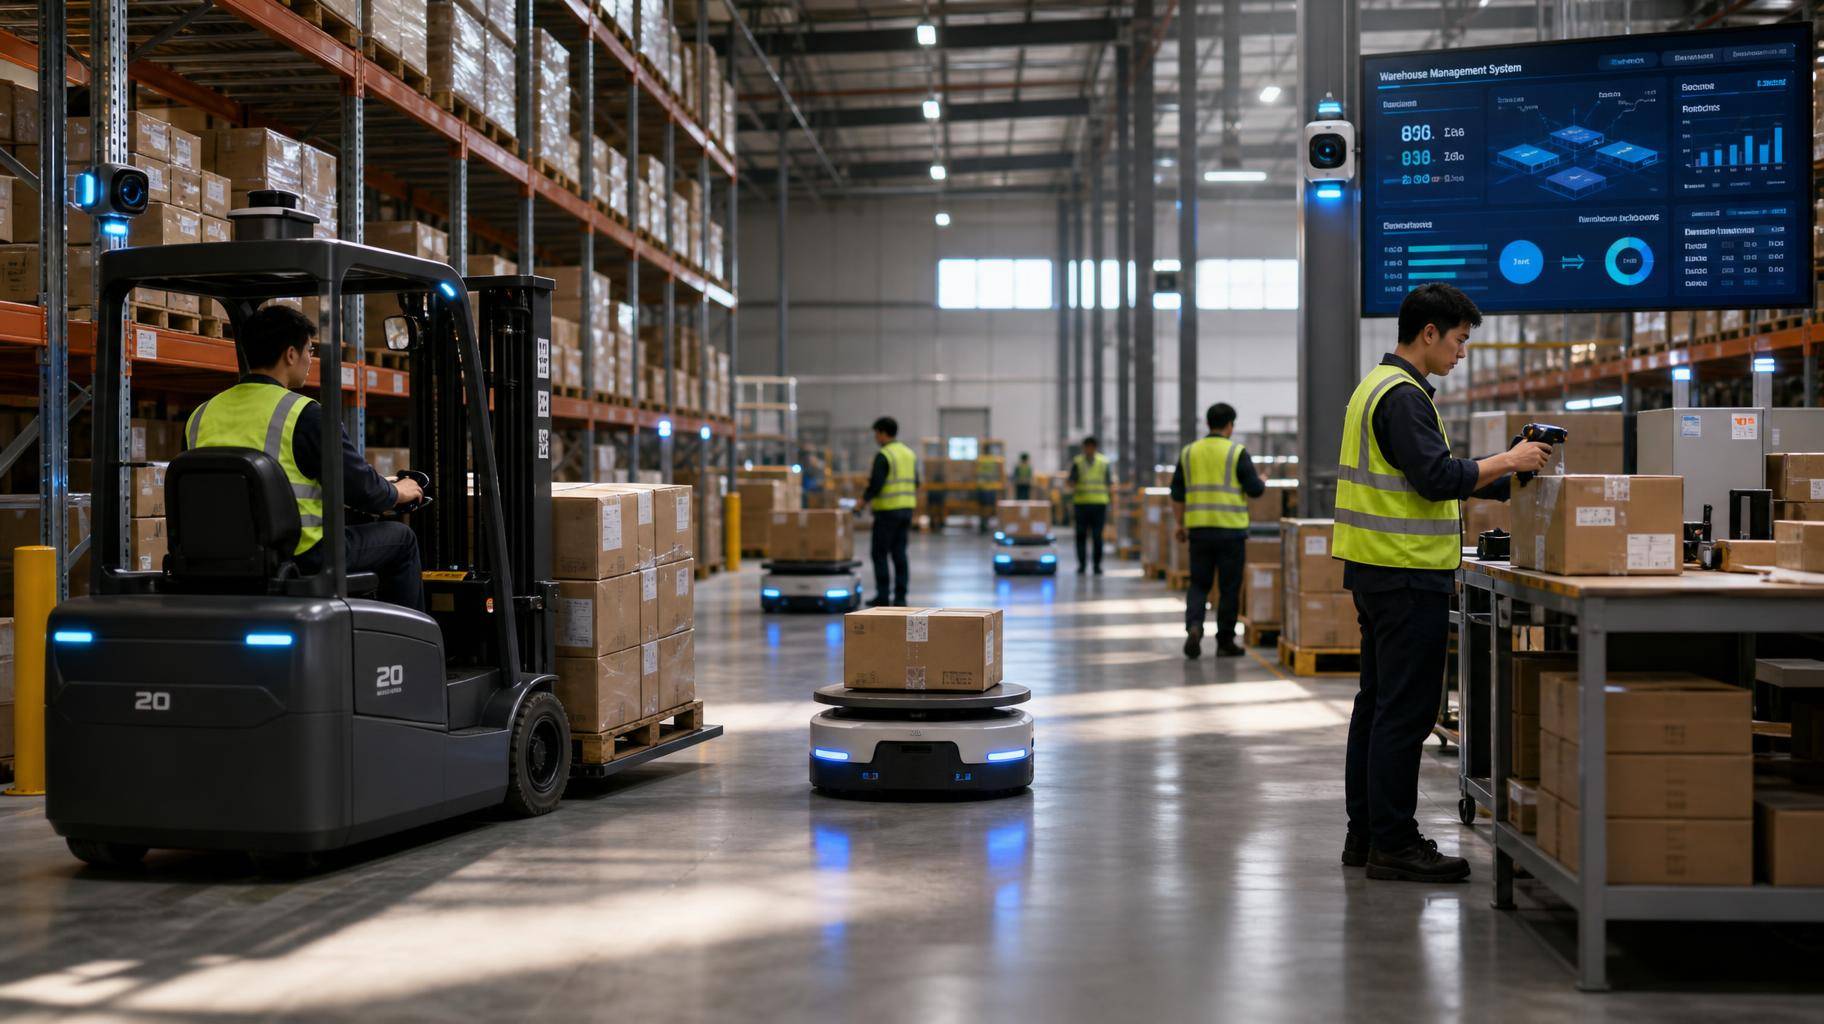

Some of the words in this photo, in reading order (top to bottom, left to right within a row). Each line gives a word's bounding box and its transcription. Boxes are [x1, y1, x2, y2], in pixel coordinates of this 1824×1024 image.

[1380, 69, 1428, 81] Warehouse
[1430, 65, 1487, 79] Management
[1489, 63, 1522, 76] System
[376, 664, 404, 688] 20
[135, 691, 171, 710] 20
